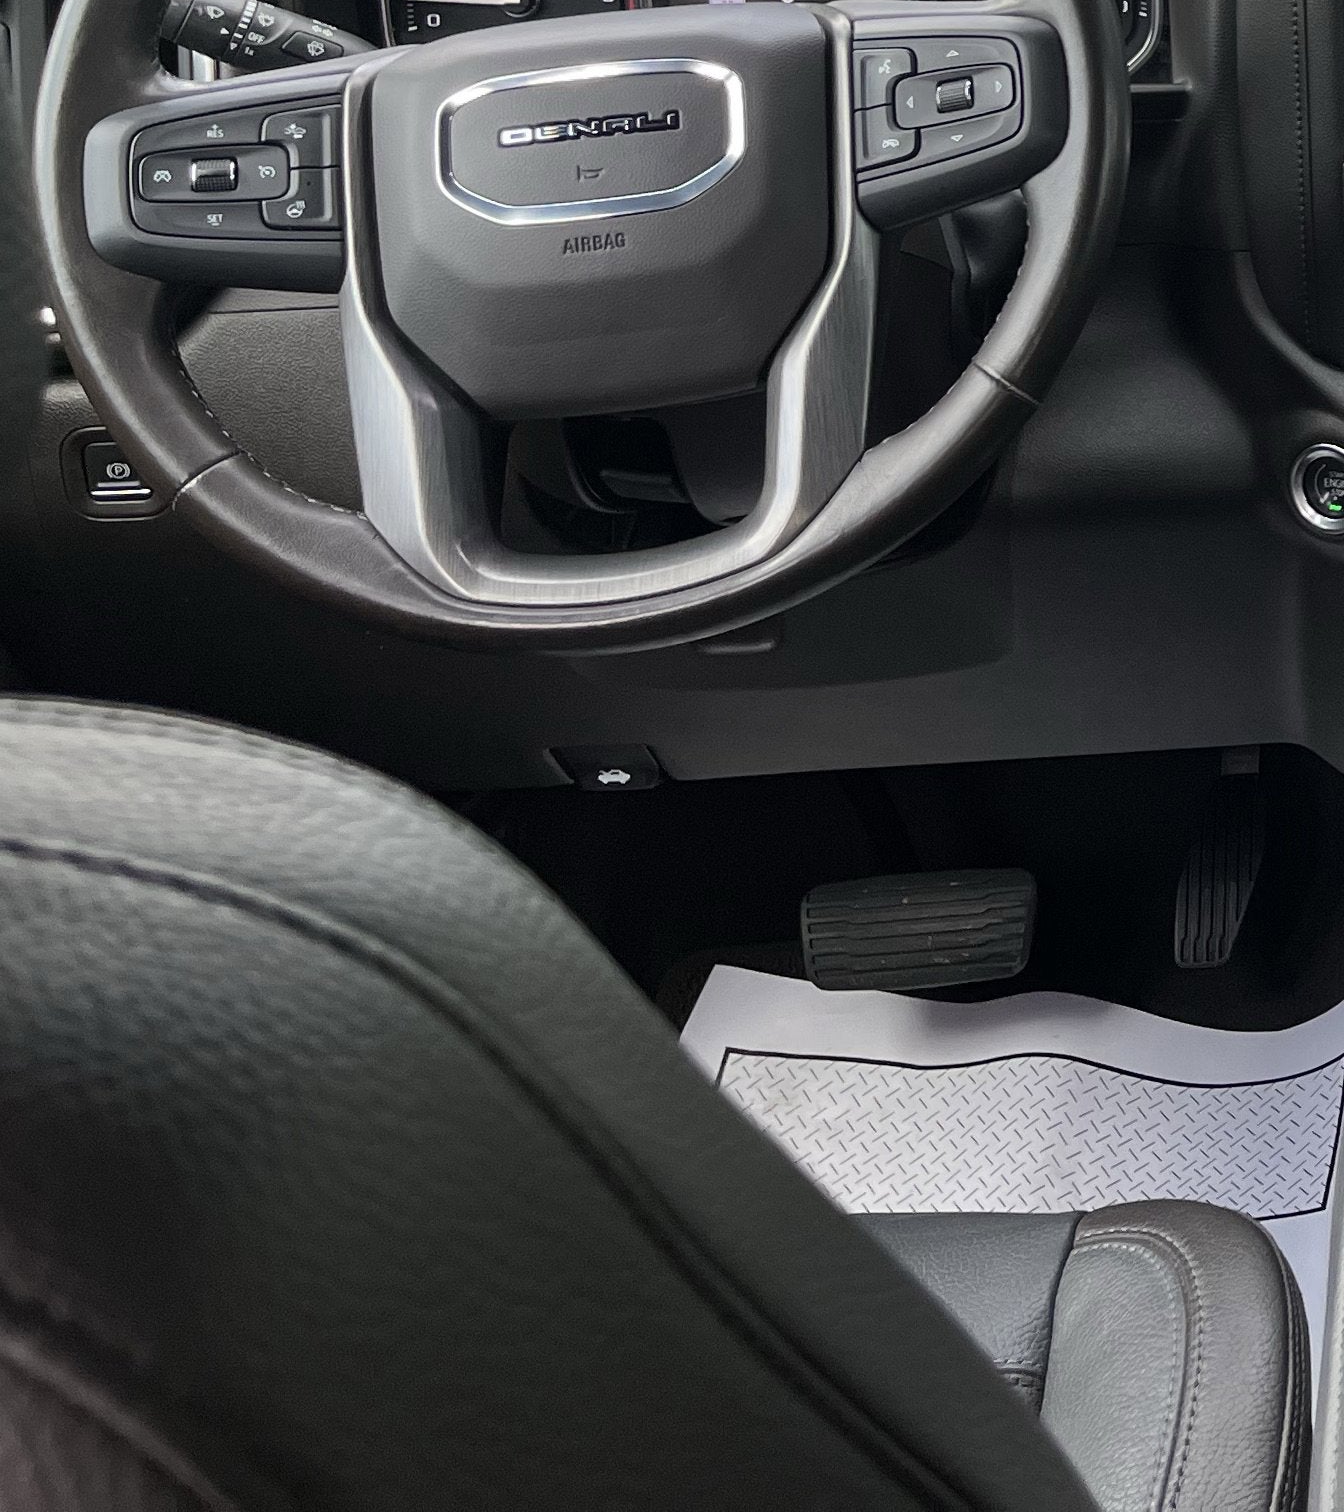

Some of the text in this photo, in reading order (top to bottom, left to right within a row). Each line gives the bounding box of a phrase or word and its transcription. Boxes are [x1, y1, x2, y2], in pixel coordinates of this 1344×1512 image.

[427, 13, 441, 28] 0
[248, 31, 266, 44] OFF
[498, 109, 681, 148] DENALI
[206, 214, 223, 224] SET
[562, 232, 626, 255] AIRBAG
